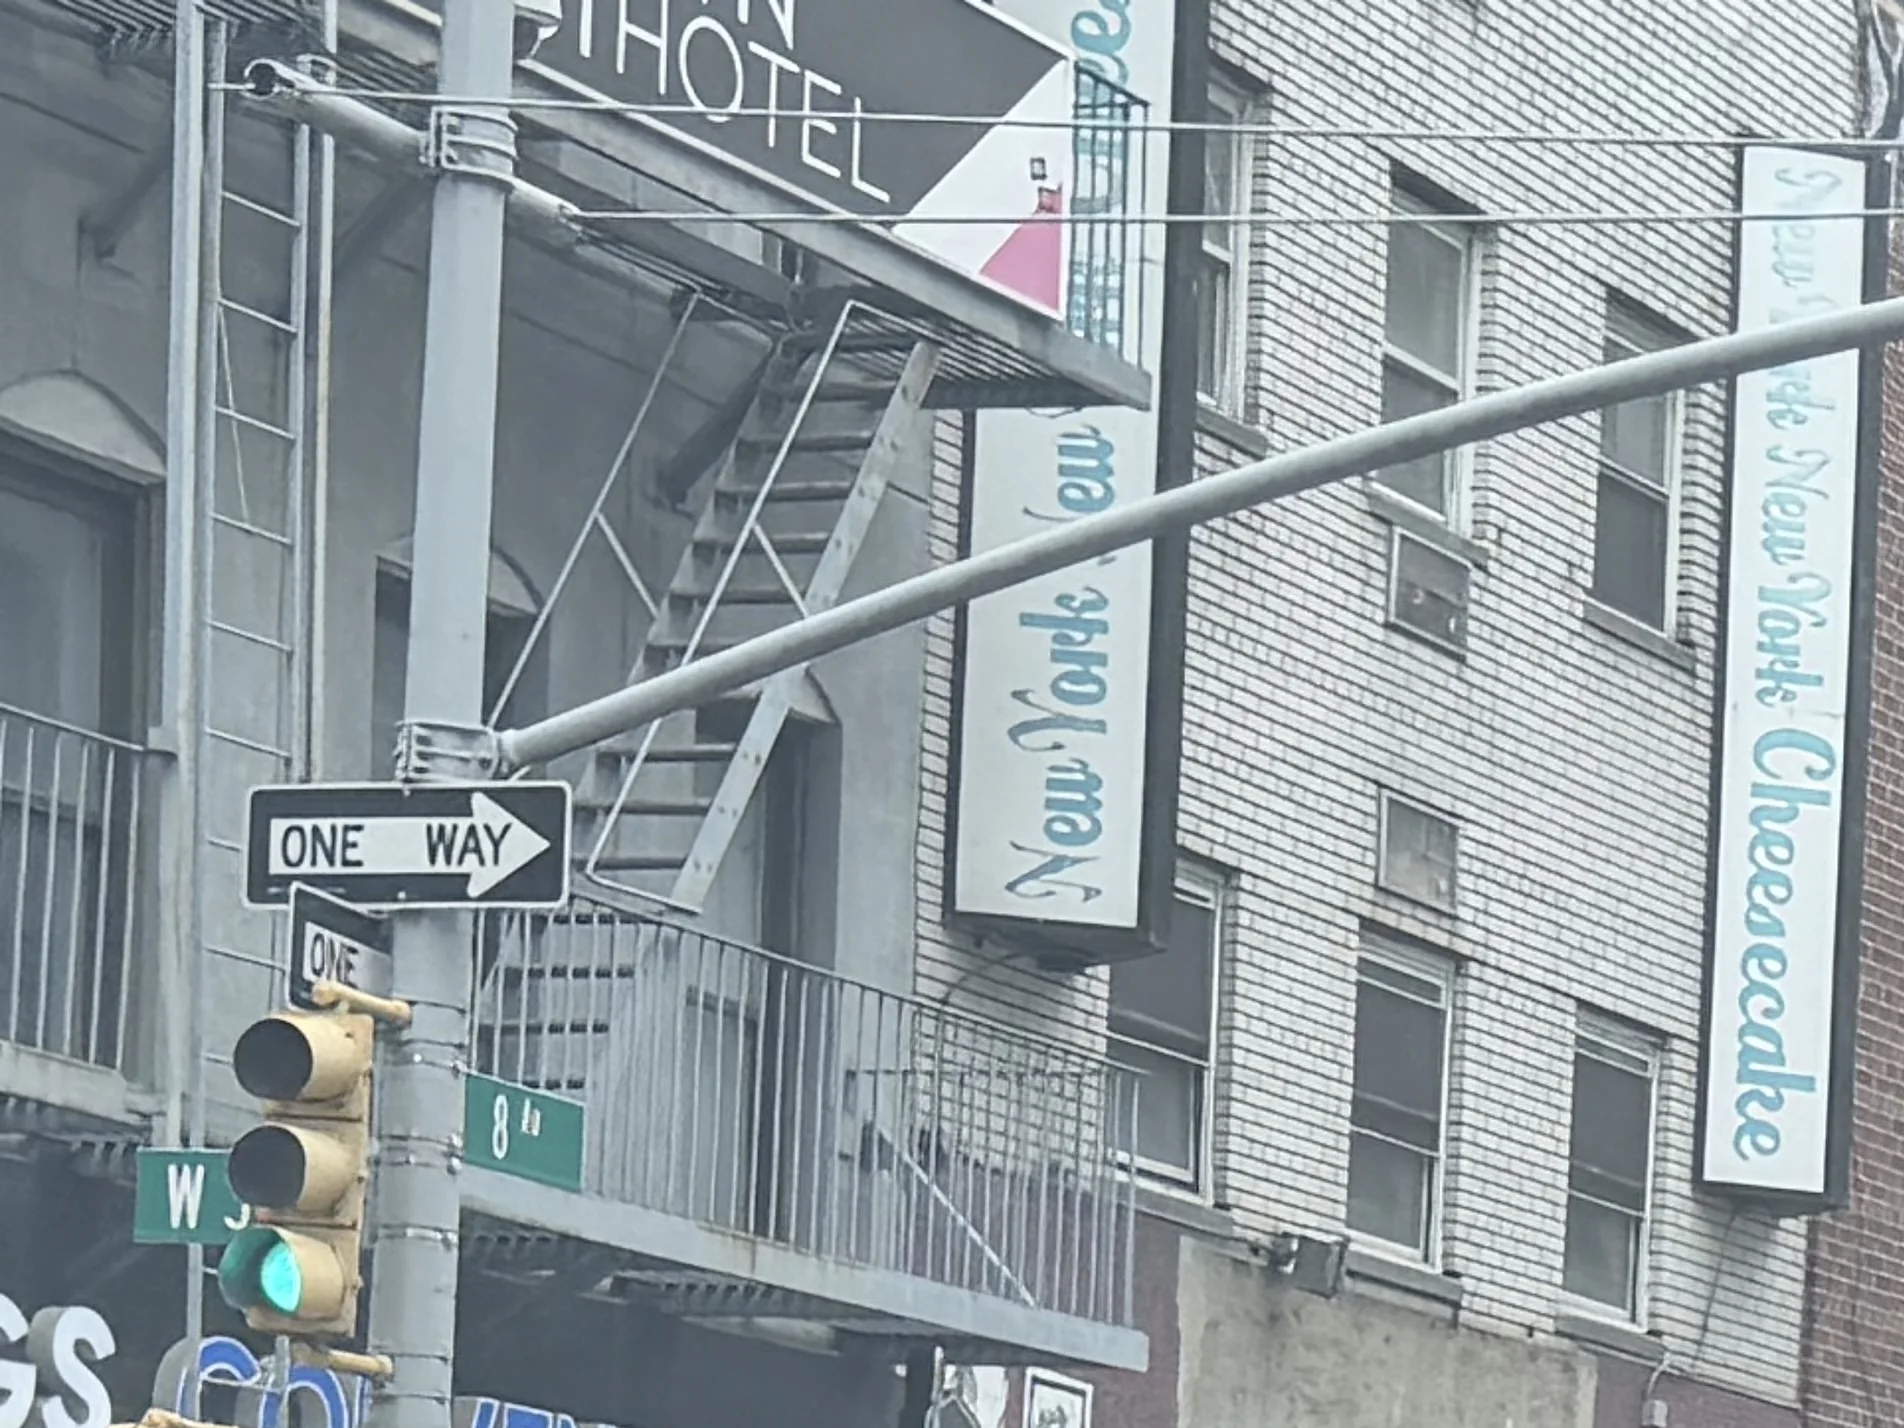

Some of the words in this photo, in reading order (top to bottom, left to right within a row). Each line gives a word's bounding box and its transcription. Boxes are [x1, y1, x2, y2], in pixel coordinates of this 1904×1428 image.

[1022, 423, 1117, 566] ew
[1007, 586, 1110, 753] York
[1754, 570, 1834, 707] York
[280, 824, 365, 868] ONE
[425, 822, 513, 868] WAY
[1003, 757, 1104, 904] New
[310, 931, 361, 990] ONE
[1732, 727, 1838, 1163] Cheesecake
[167, 1163, 205, 1230] W
